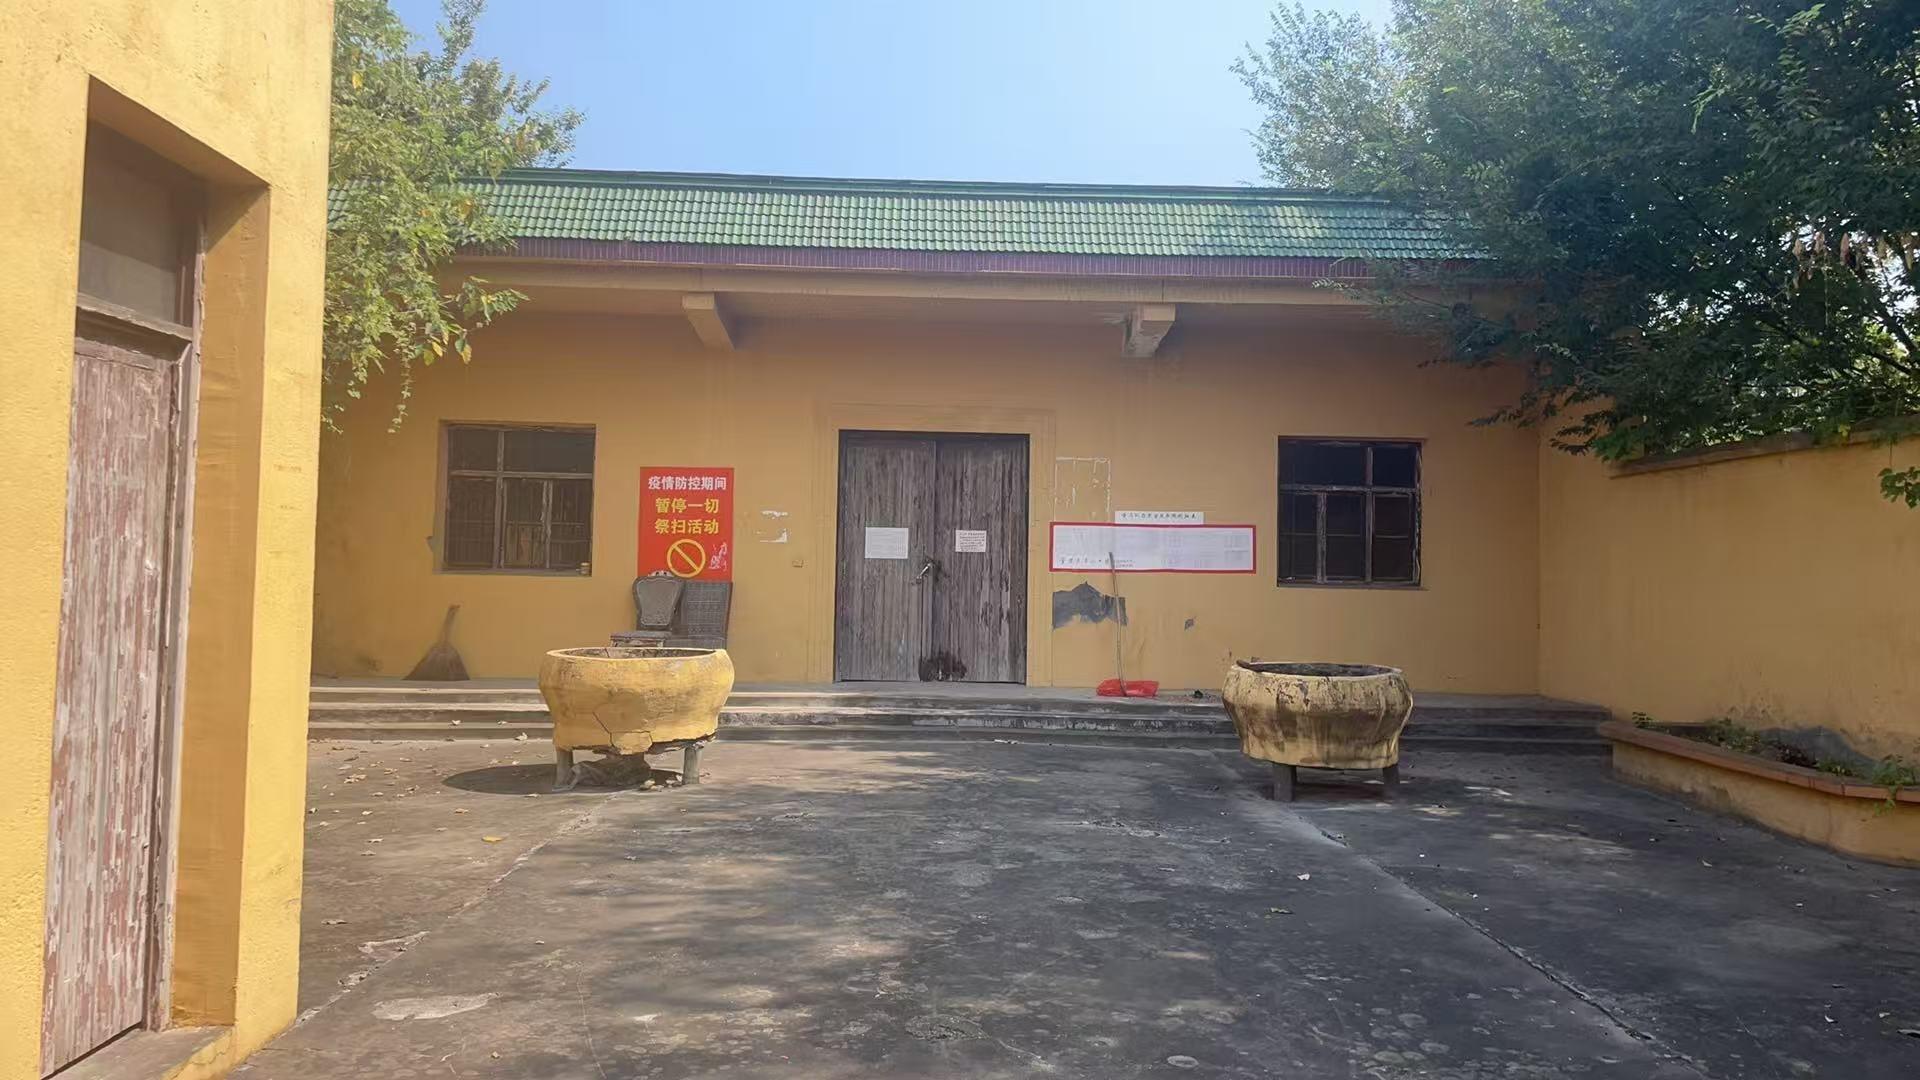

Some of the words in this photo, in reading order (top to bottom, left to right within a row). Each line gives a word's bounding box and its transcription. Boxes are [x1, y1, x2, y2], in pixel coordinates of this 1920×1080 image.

[648, 476, 727, 490] 疫情防控期间
[655, 498, 719, 514] 暂停一切
[655, 519, 719, 534] 祭扫活动
